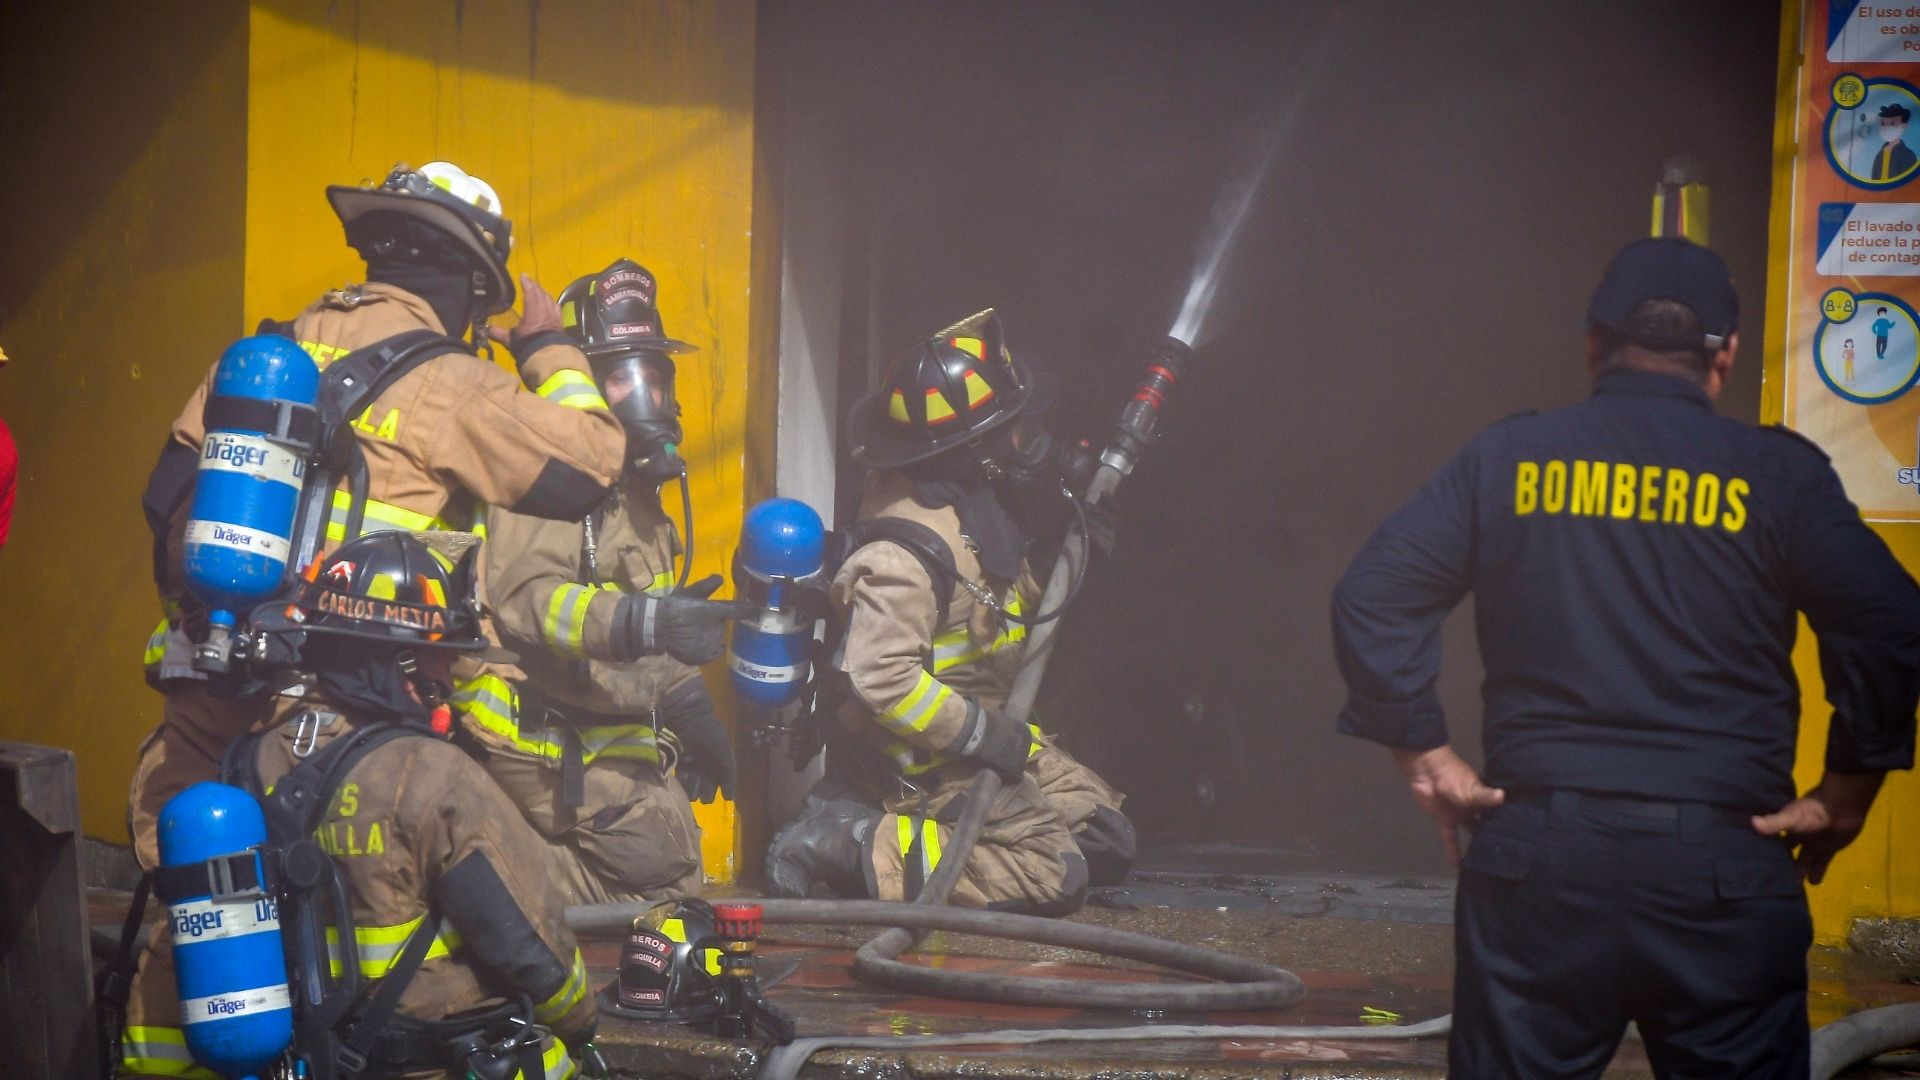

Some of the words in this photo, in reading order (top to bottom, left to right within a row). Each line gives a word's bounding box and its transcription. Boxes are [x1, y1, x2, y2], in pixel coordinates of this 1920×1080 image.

[1859, 6, 1872, 17] El
[1877, 9, 1902, 17] uso
[1881, 26, 1896, 34] es
[1848, 221, 1861, 231] El
[1866, 221, 1913, 231] lavado
[1842, 236, 1890, 247] reduce
[1895, 236, 1907, 248] la
[1849, 252, 1867, 262] de
[603, 273, 650, 289] BOMBEROS
[205, 436, 269, 467] Dräger
[1516, 460, 1749, 532] BOMBEROS
[214, 526, 253, 545] Dräger
[318, 589, 375, 619] CARLOS
[207, 1000, 246, 1015] Dräger
